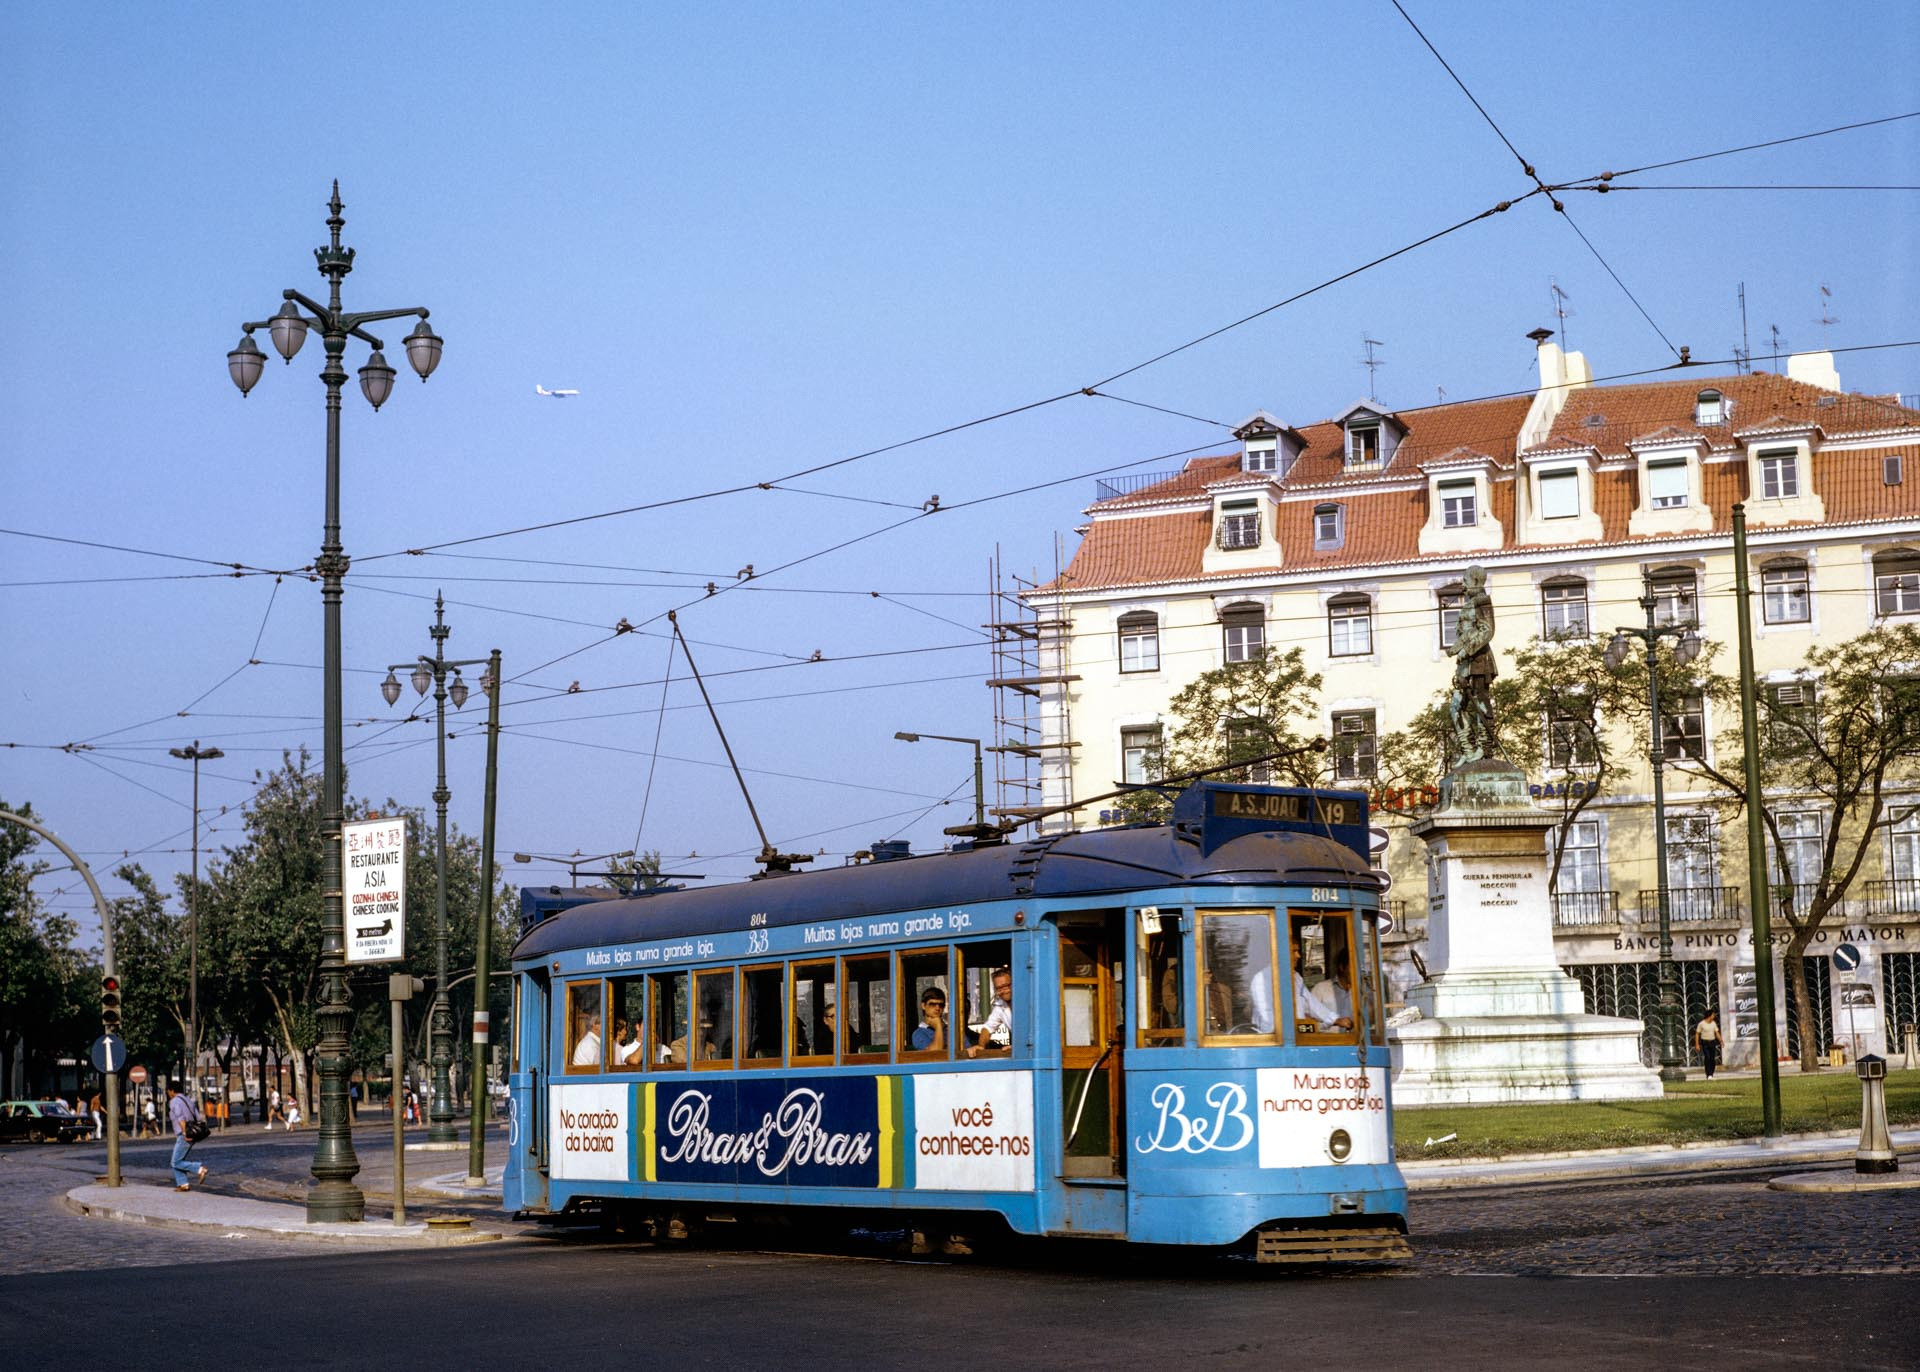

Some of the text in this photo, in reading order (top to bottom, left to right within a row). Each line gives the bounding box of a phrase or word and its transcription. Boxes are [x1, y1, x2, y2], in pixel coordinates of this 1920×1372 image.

[1326, 803, 1344, 824] 19
[351, 851, 399, 868] RESTAURANTE
[364, 870, 387, 888] ASIA
[352, 891, 399, 904] COZINHA CHINESA
[1311, 887, 1339, 902] 804
[352, 902, 399, 916] CHINESE COOKING
[750, 913, 767, 926] 804
[804, 911, 972, 944] Muitas lojas numa grande loja.
[1685, 933, 1738, 948] PINTO
[1839, 927, 1905, 942] MAYOR
[586, 940, 715, 967] Muitas lojas numa grande loja.
[1293, 1073, 1341, 1090] Muitas
[952, 1102, 993, 1128] você
[1263, 1098, 1313, 1112] numa
[1317, 1095, 1365, 1115] grande
[560, 1109, 619, 1134] No coração
[1135, 1081, 1255, 1154] B&B
[565, 1132, 614, 1153] da baixa
[920, 1130, 1030, 1156] conhece-nos
